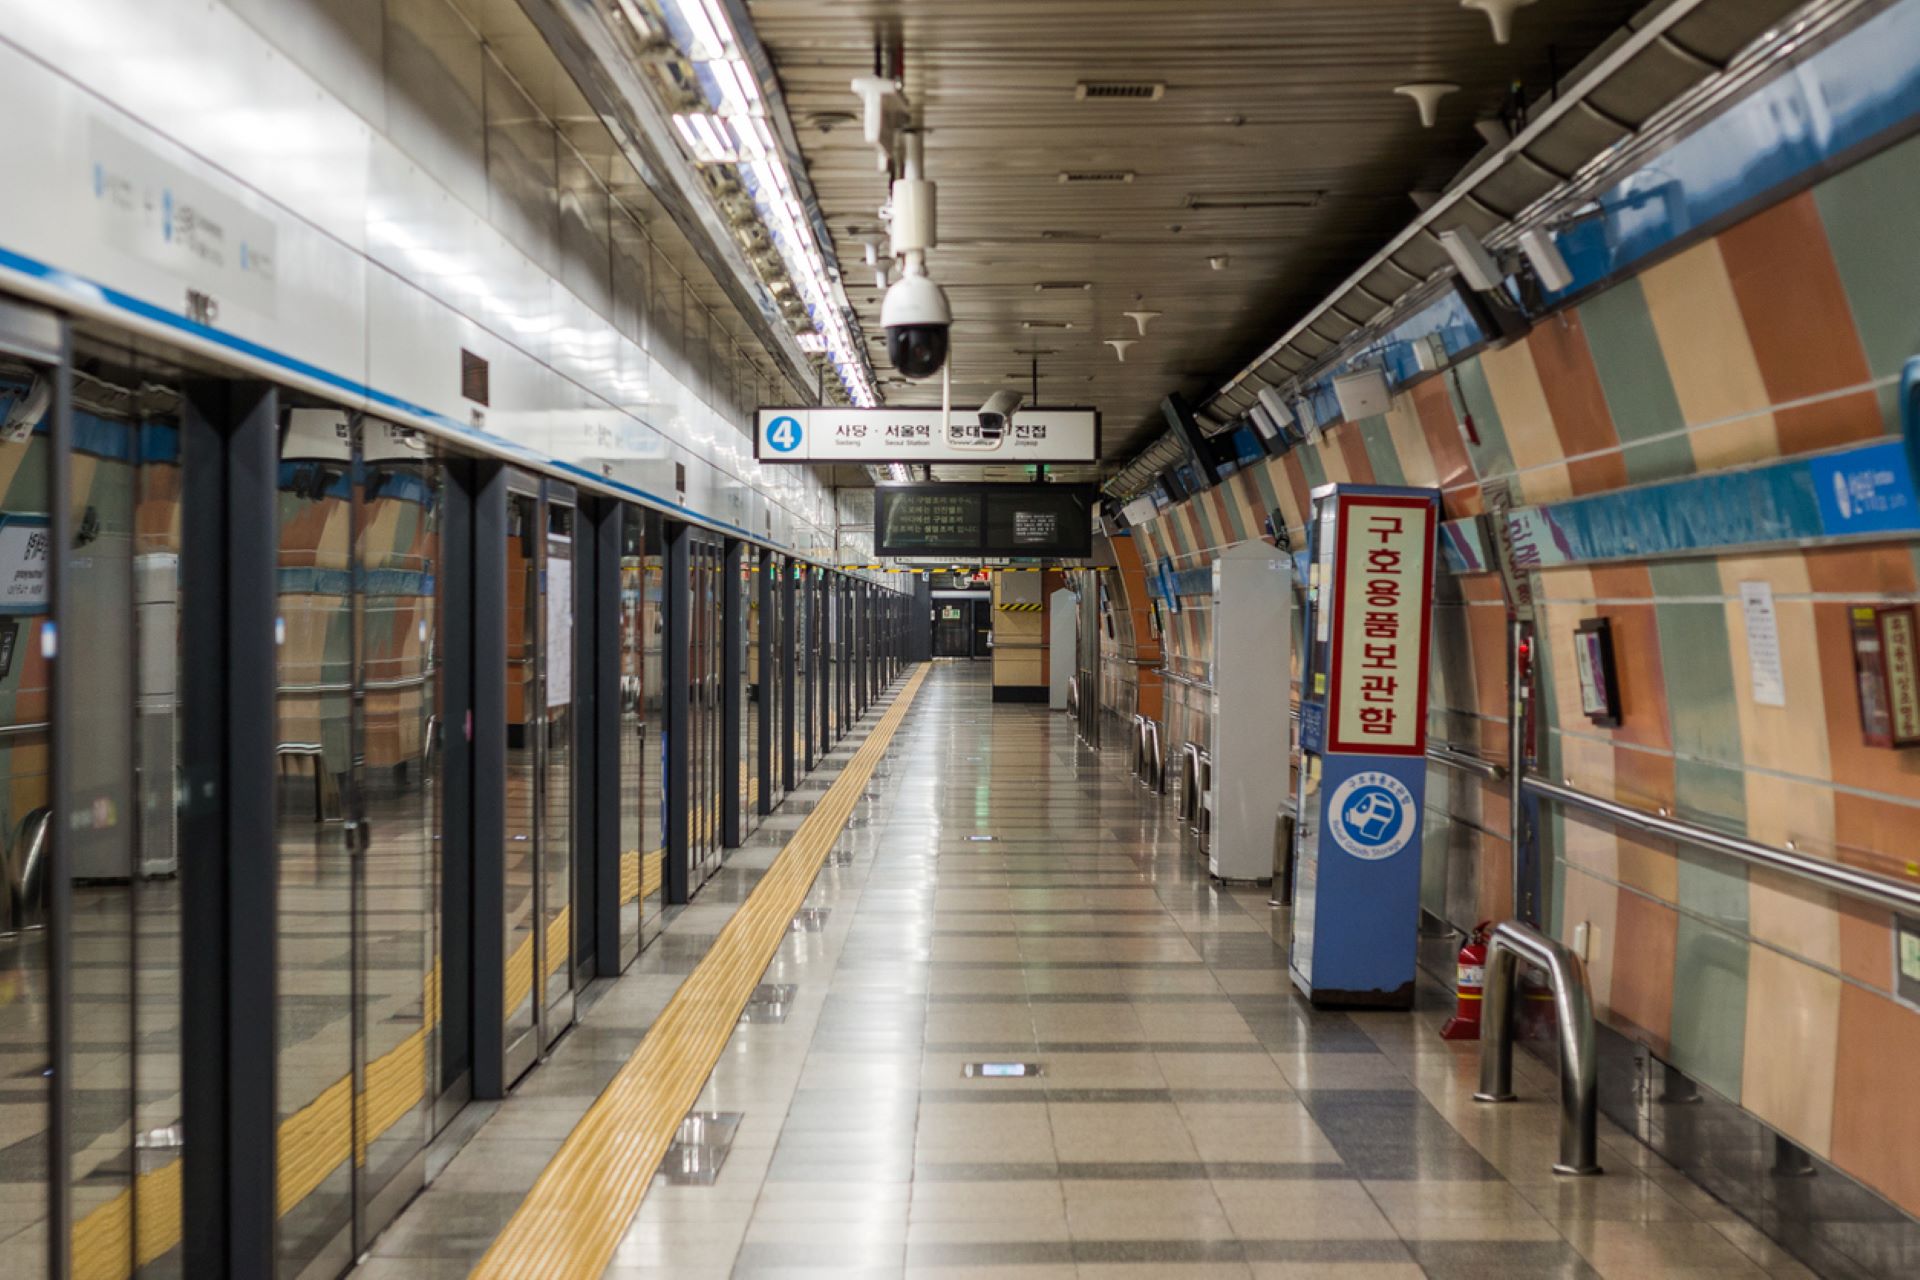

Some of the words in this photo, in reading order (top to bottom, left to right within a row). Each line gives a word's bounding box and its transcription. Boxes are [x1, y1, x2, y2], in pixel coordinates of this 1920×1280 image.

[772, 420, 794, 448] 4
[836, 424, 868, 438] 사당
[885, 424, 931, 438] 서울역
[1015, 424, 1047, 439] 진접
[1359, 516, 1404, 735] 구호용품보관함
